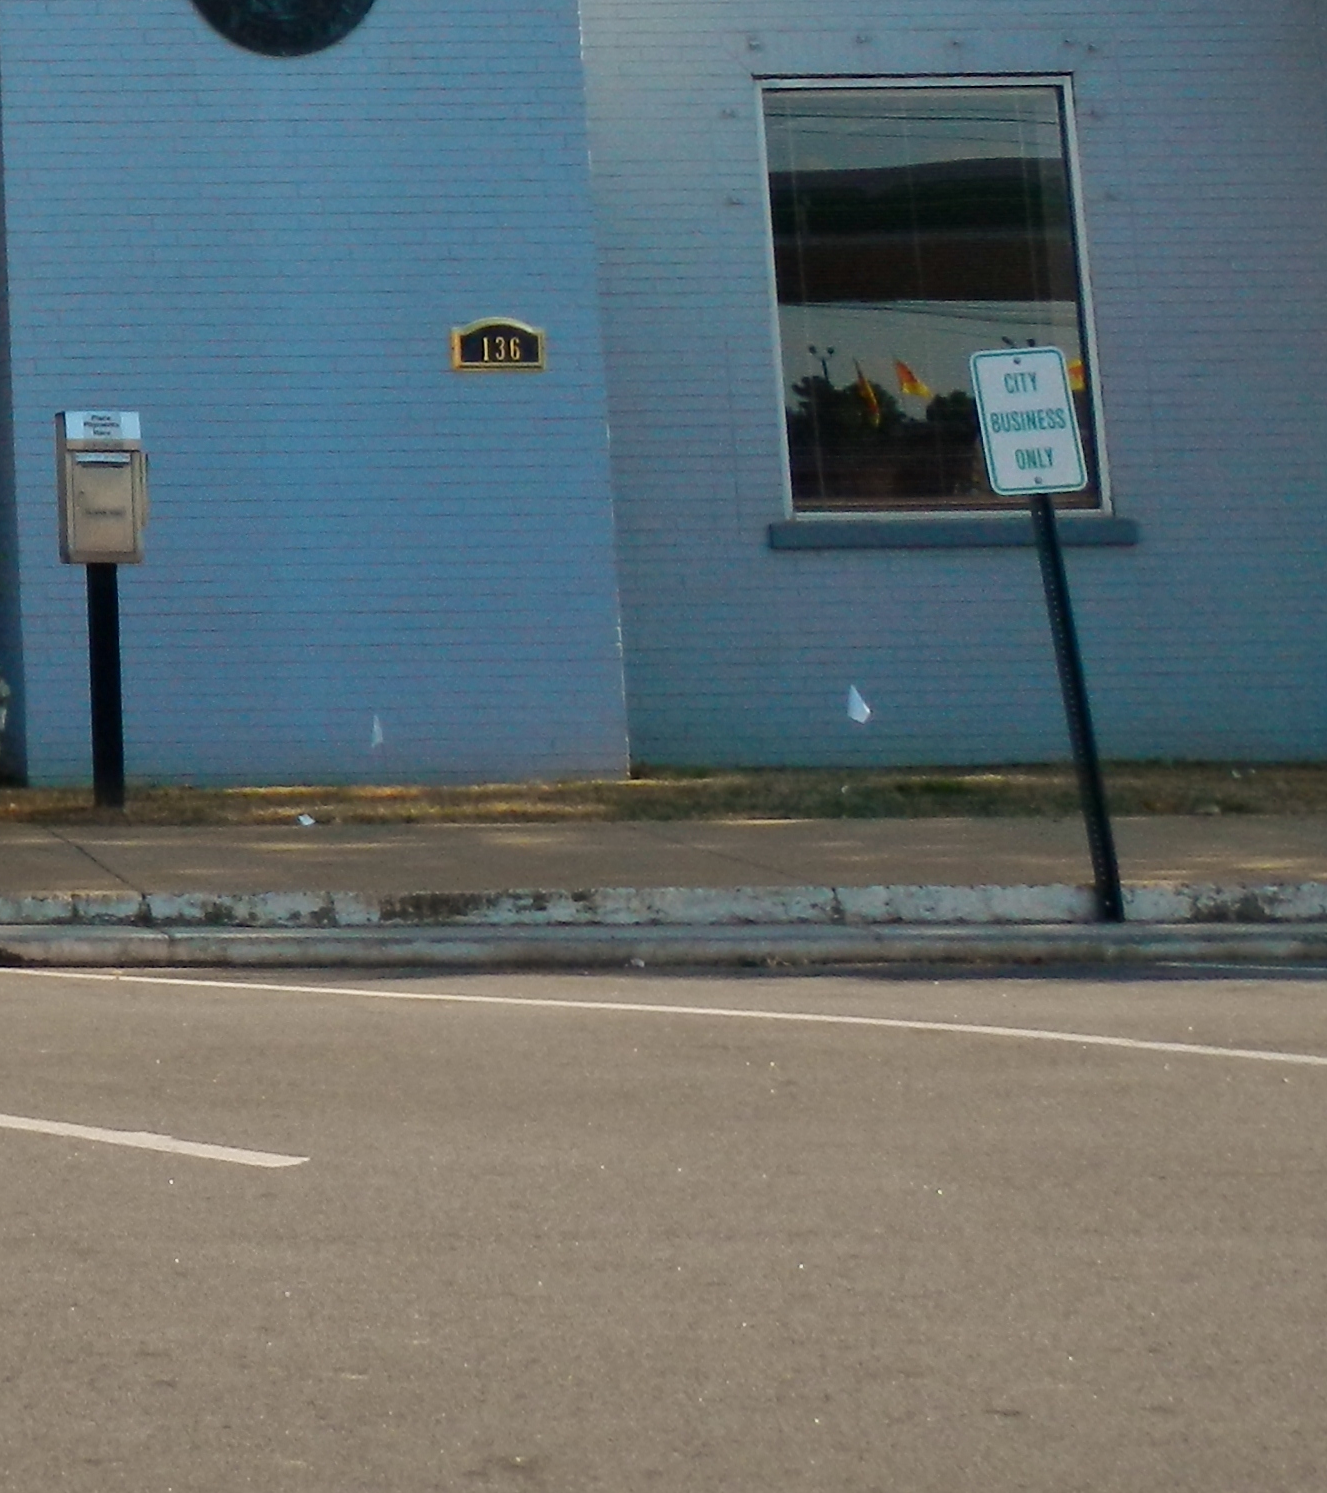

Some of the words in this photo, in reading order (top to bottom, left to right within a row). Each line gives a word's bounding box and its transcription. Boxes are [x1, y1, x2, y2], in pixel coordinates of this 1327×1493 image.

[483, 336, 521, 361] 136
[1004, 373, 1037, 394] CITY
[990, 408, 1067, 433] BUSINESS
[1015, 447, 1054, 470] ONLY
